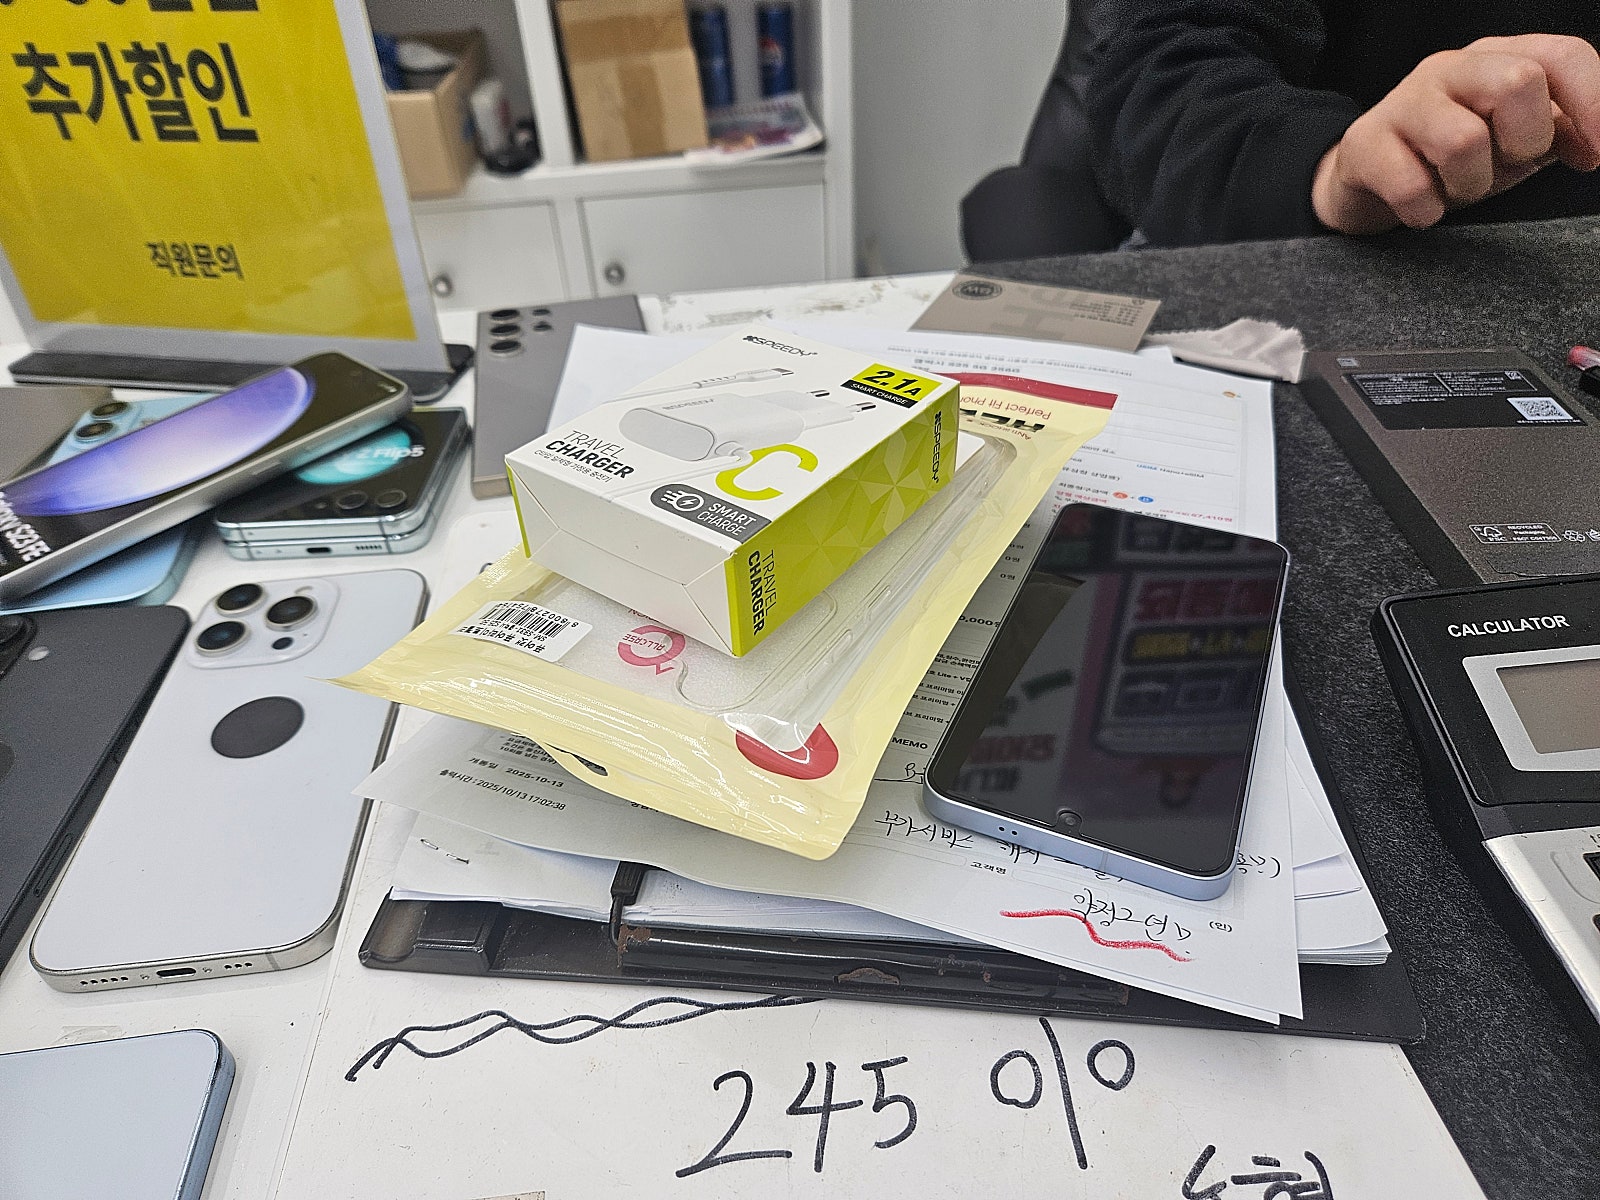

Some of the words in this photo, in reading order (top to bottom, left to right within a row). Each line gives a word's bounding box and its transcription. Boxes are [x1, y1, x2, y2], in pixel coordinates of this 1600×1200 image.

[11, 42, 260, 143] 추가할인
[145, 241, 245, 280] 직원문의
[751, 337, 813, 357] SPEEDY
[850, 383, 877, 394] SMART
[876, 391, 909, 405] CHARGE
[988, 399, 1003, 410] Fit
[1005, 402, 1052, 420] Perfect
[372, 445, 426, 461] Flip5
[563, 430, 625, 460] TRAVEL
[932, 422, 942, 482] SPEEDY
[545, 440, 635, 479] CHARGER
[715, 443, 819, 501] C
[696, 511, 747, 536] CHARGE
[708, 502, 757, 526] SMART
[748, 550, 765, 636] CHARGER
[762, 549, 777, 617] TRAVEL
[1447, 614, 1570, 638] CALCULATOR
[622, 633, 666, 651] ALLCASE
[891, 737, 928, 750] MEMO
[468, 757, 500, 769] 개통일
[505, 767, 565, 788] 2025-10-13
[528, 795, 567, 811] 17:02:38
[675, 1056, 918, 1178] 245
